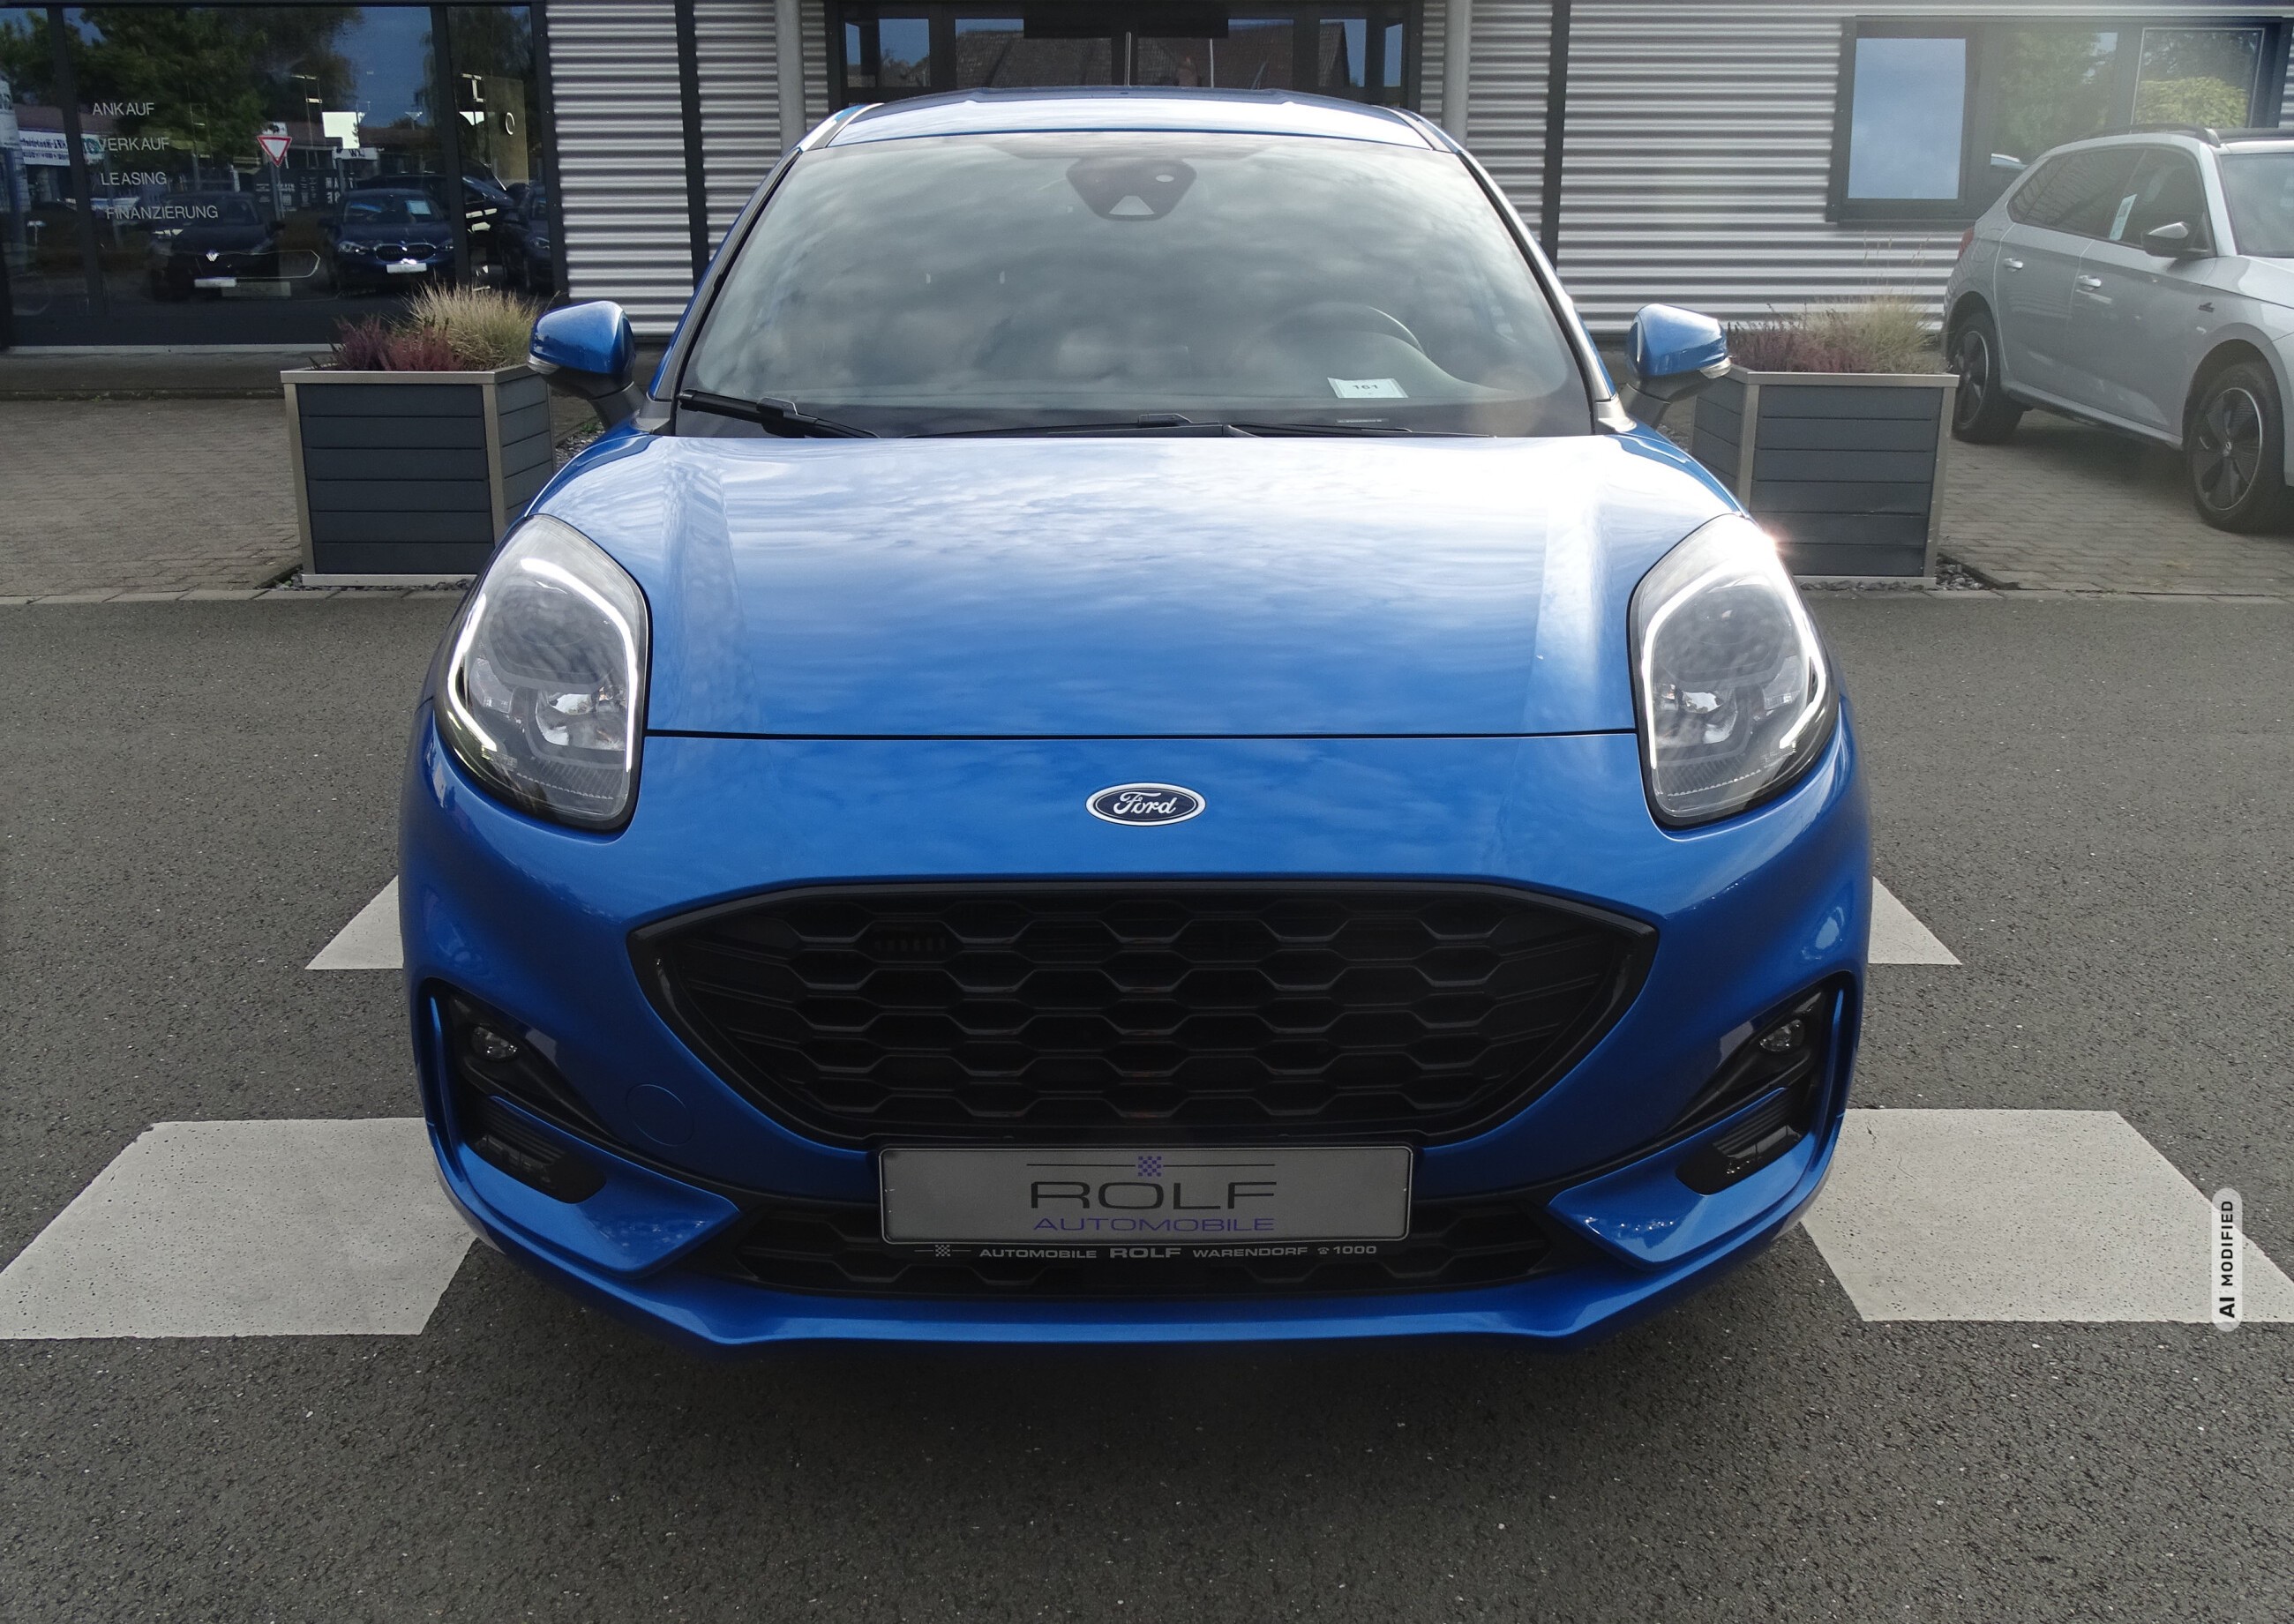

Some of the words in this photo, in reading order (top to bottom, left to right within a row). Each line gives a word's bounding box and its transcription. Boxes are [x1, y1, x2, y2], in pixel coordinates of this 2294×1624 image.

[92, 102, 154, 116] ANKAUF
[98, 137, 169, 151] VERKAUF
[101, 171, 168, 185] LEASING
[106, 205, 219, 220] FINANZIERUNG
[1113, 791, 1178, 815] Ford
[1031, 1181, 1277, 1209] ROLF
[1033, 1218, 1276, 1231] AUTOMOBILE
[978, 1248, 1097, 1259] AUTOMOBILE
[1109, 1247, 1182, 1259] ROLF
[1192, 1246, 1308, 1258] WARENDORF
[1333, 1246, 1377, 1254] 1000
